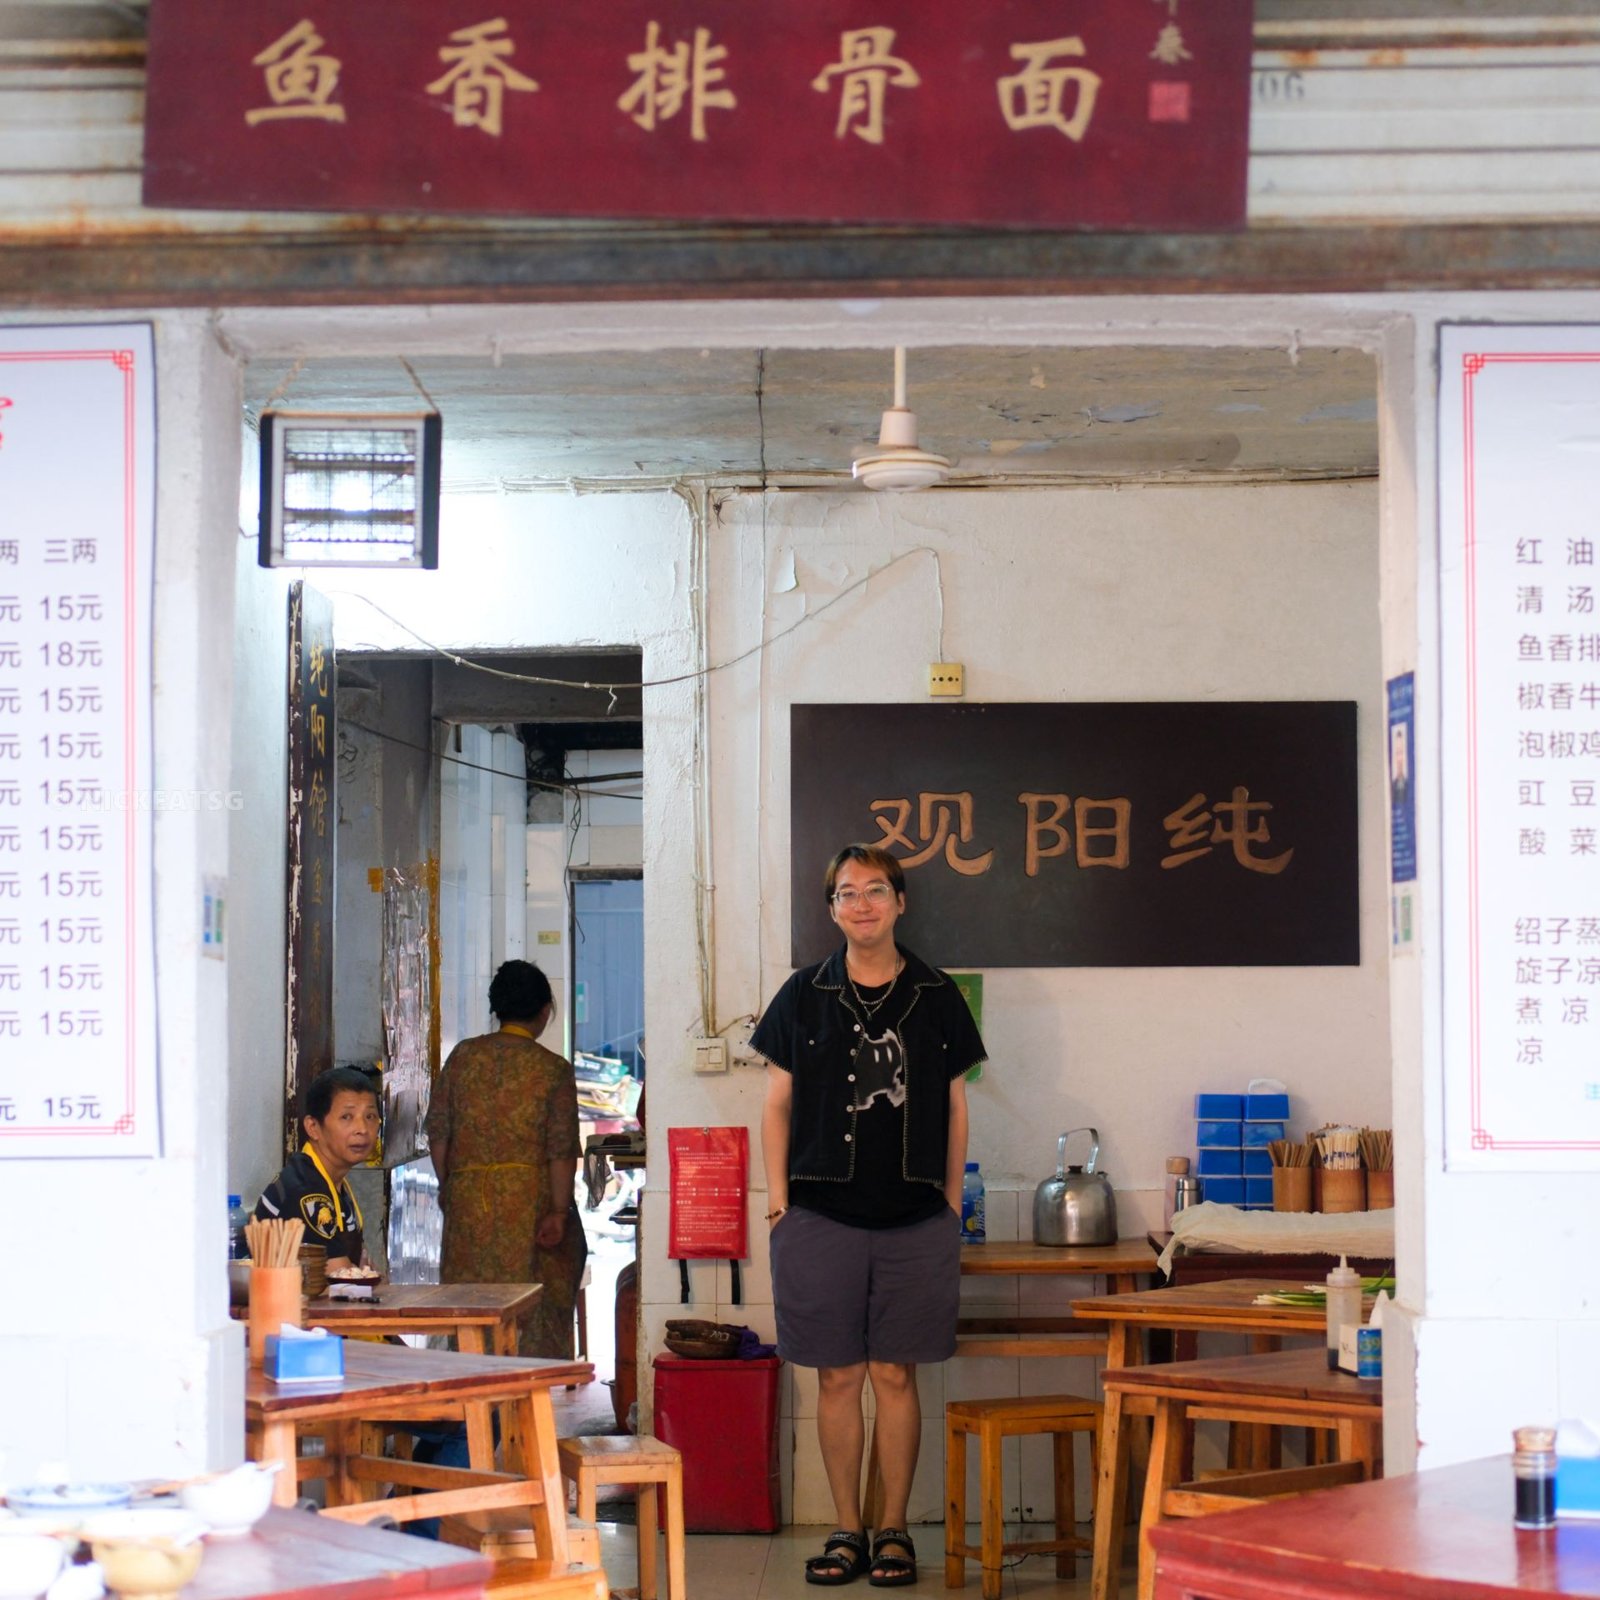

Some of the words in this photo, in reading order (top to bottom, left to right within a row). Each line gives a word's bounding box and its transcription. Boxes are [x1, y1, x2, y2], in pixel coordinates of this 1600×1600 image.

[246, 18, 1102, 143] 鱼香排骨面
[43, 538, 98, 565] 三两
[38, 594, 103, 623] 15元
[38, 641, 103, 668] 18元
[38, 687, 103, 714] 15元
[38, 733, 103, 760] 15元
[38, 780, 103, 806] 15元
[38, 825, 103, 852] 15元
[39, 871, 103, 898] 15元
[39, 918, 103, 945] 15元
[39, 965, 103, 991] 15元
[39, 1010, 103, 1037] 15元
[44, 1096, 102, 1121] 15元
